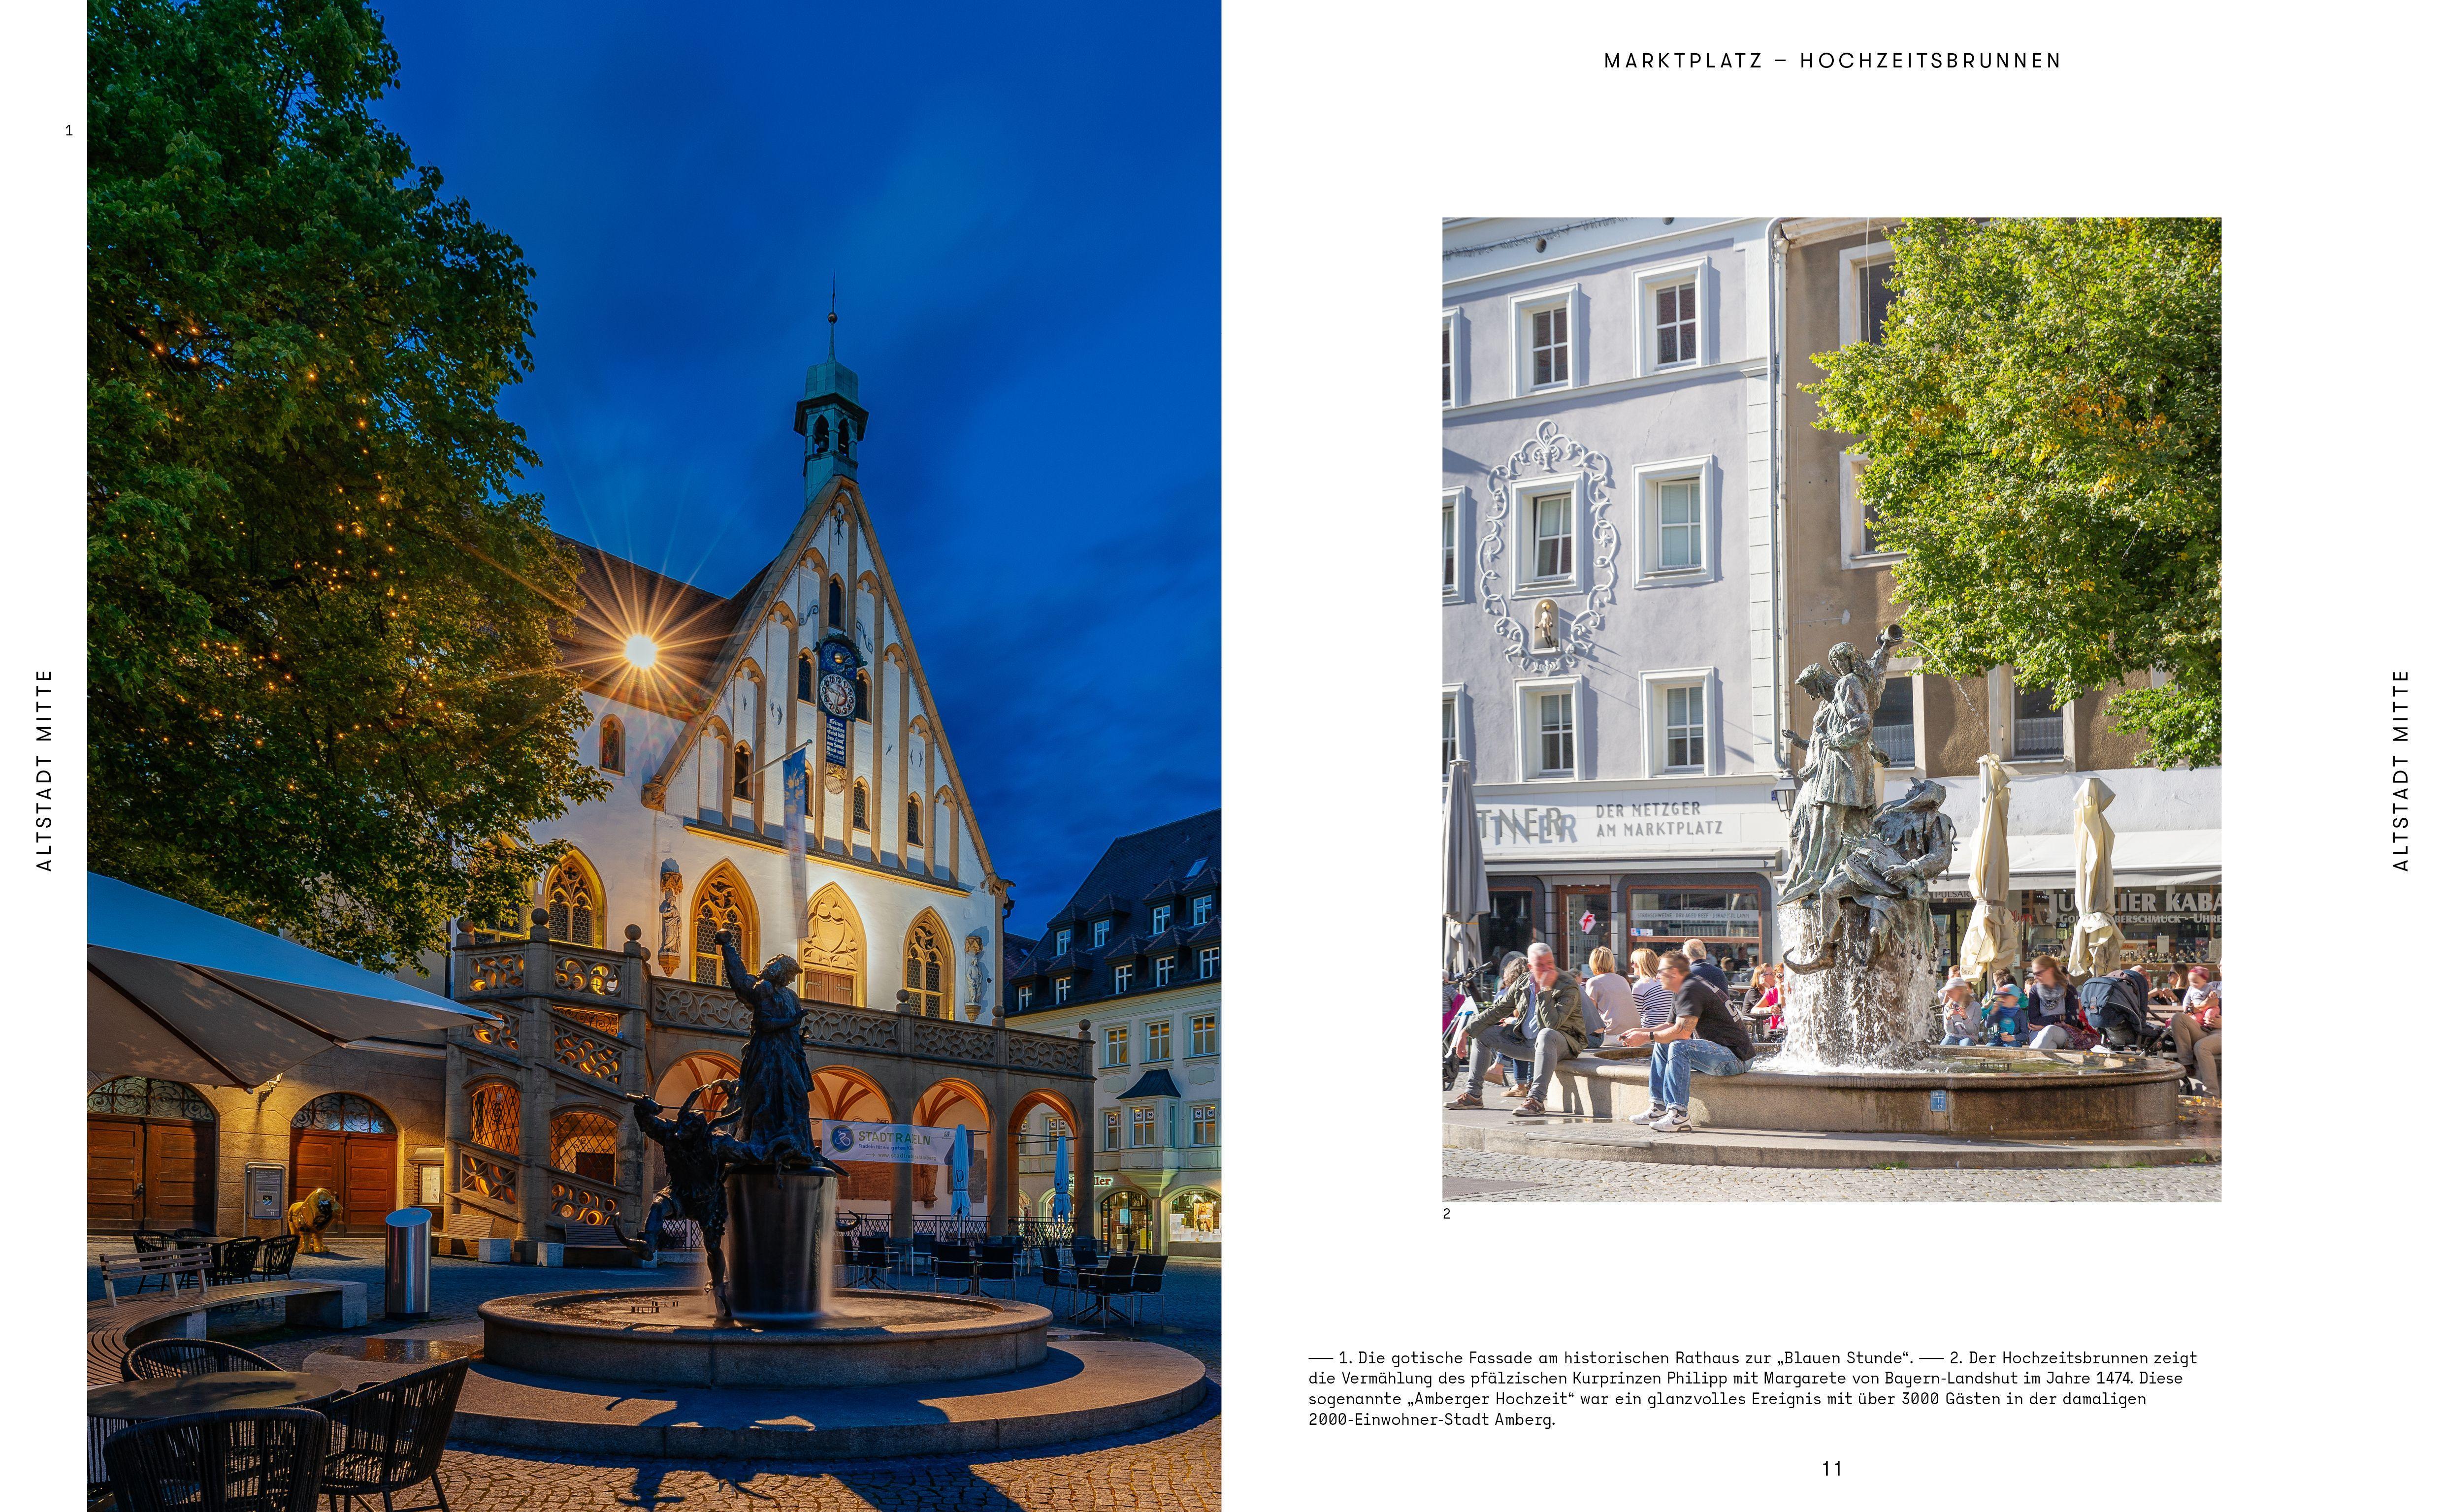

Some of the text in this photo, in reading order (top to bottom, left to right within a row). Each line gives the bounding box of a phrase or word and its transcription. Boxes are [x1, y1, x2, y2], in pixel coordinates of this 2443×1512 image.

[1596, 801, 1700, 818] DER METZGER
[1476, 807, 1563, 840] TNER
[1596, 820, 1723, 837] AM MARKTPLATZ
[2114, 915, 2182, 923] BERSCHMUCK
[1093, 1176, 1112, 1185] ler
